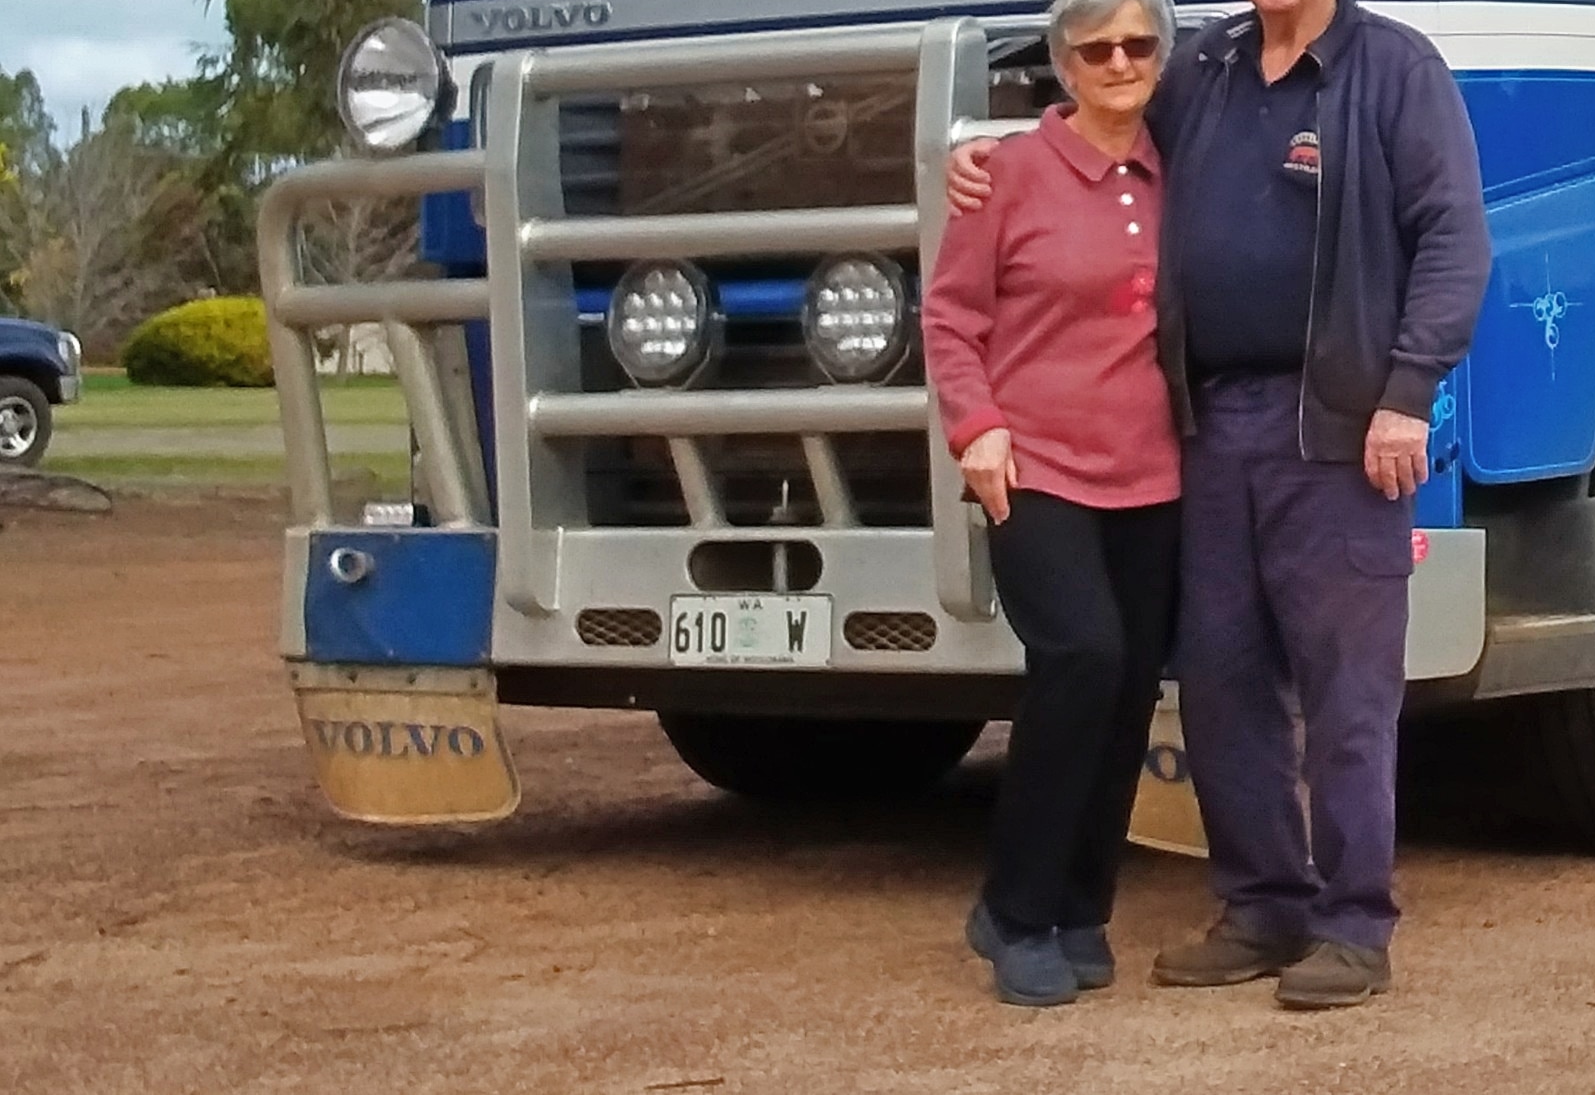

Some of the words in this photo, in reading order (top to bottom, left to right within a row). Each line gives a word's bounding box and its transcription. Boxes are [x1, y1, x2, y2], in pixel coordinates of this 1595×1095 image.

[470, 0, 614, 33] VOLVO
[739, 599, 763, 610] WA
[675, 611, 726, 653] 610
[786, 610, 807, 653] W
[312, 719, 485, 758] VOLVO
